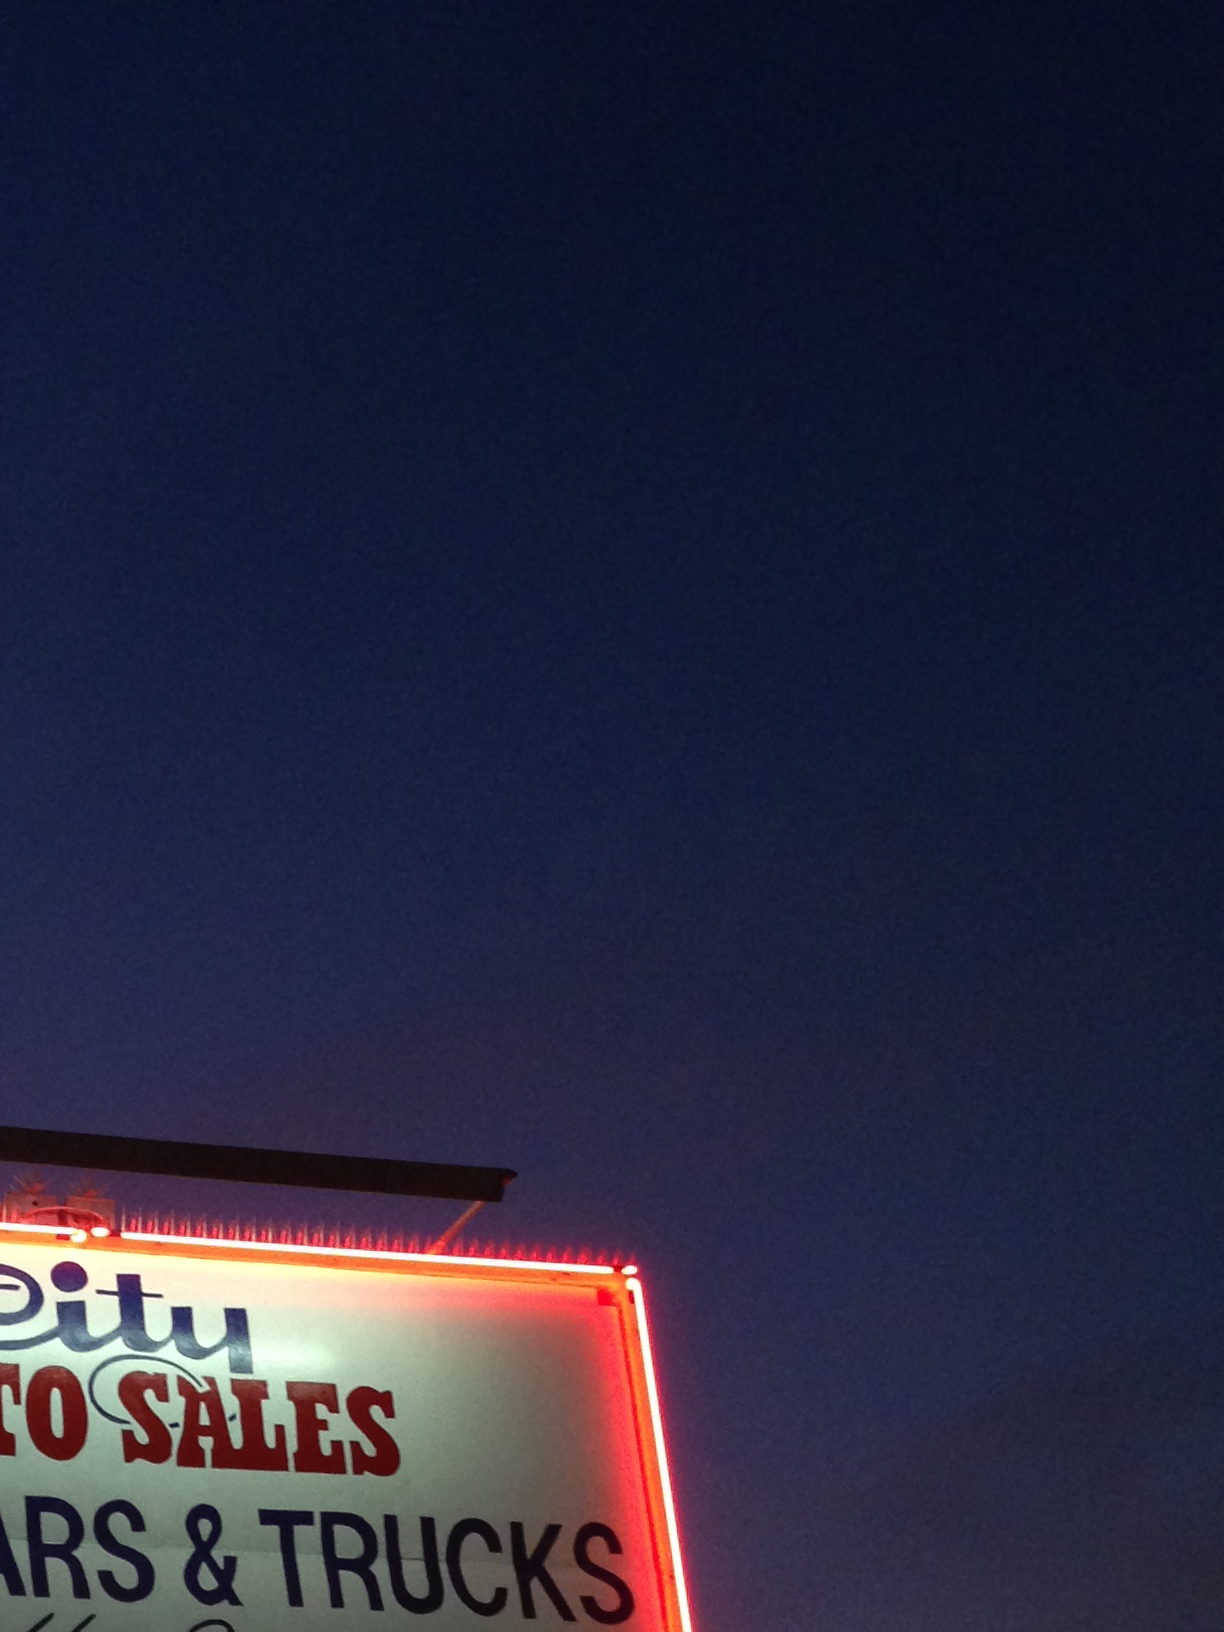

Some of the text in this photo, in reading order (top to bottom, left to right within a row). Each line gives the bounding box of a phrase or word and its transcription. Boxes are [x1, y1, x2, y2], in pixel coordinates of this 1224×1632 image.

[118, 1369, 401, 1477] SALES
[182, 1504, 244, 1607] &
[258, 1508, 635, 1625] TRUCKS
